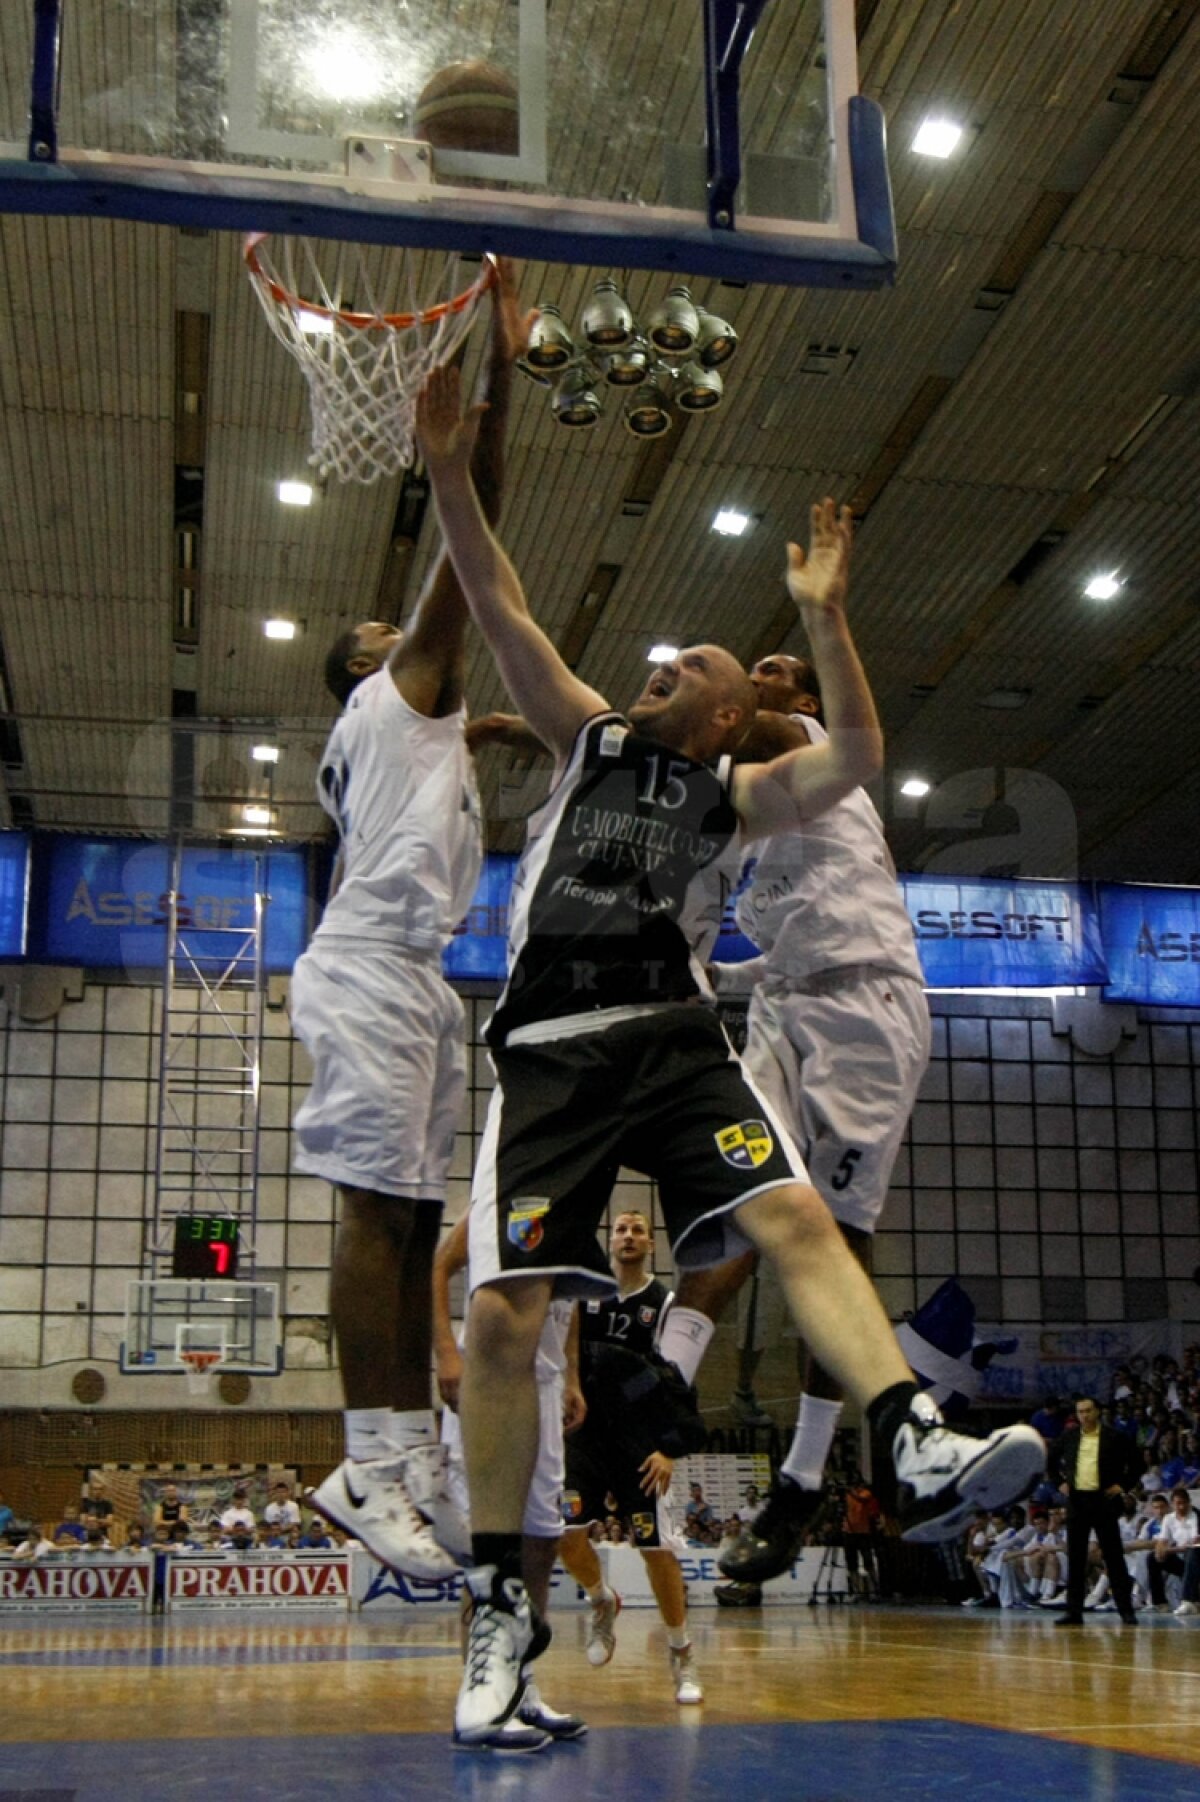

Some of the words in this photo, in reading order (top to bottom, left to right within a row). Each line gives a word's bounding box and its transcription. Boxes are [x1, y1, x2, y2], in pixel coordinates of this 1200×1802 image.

[637, 754, 689, 809] 15
[912, 910, 1069, 941] SESOFT
[831, 1148, 862, 1191] 5
[208, 1242, 230, 1274] 7
[606, 1311, 631, 1339] 12
[173, 1566, 345, 1597] PRAHOVA
